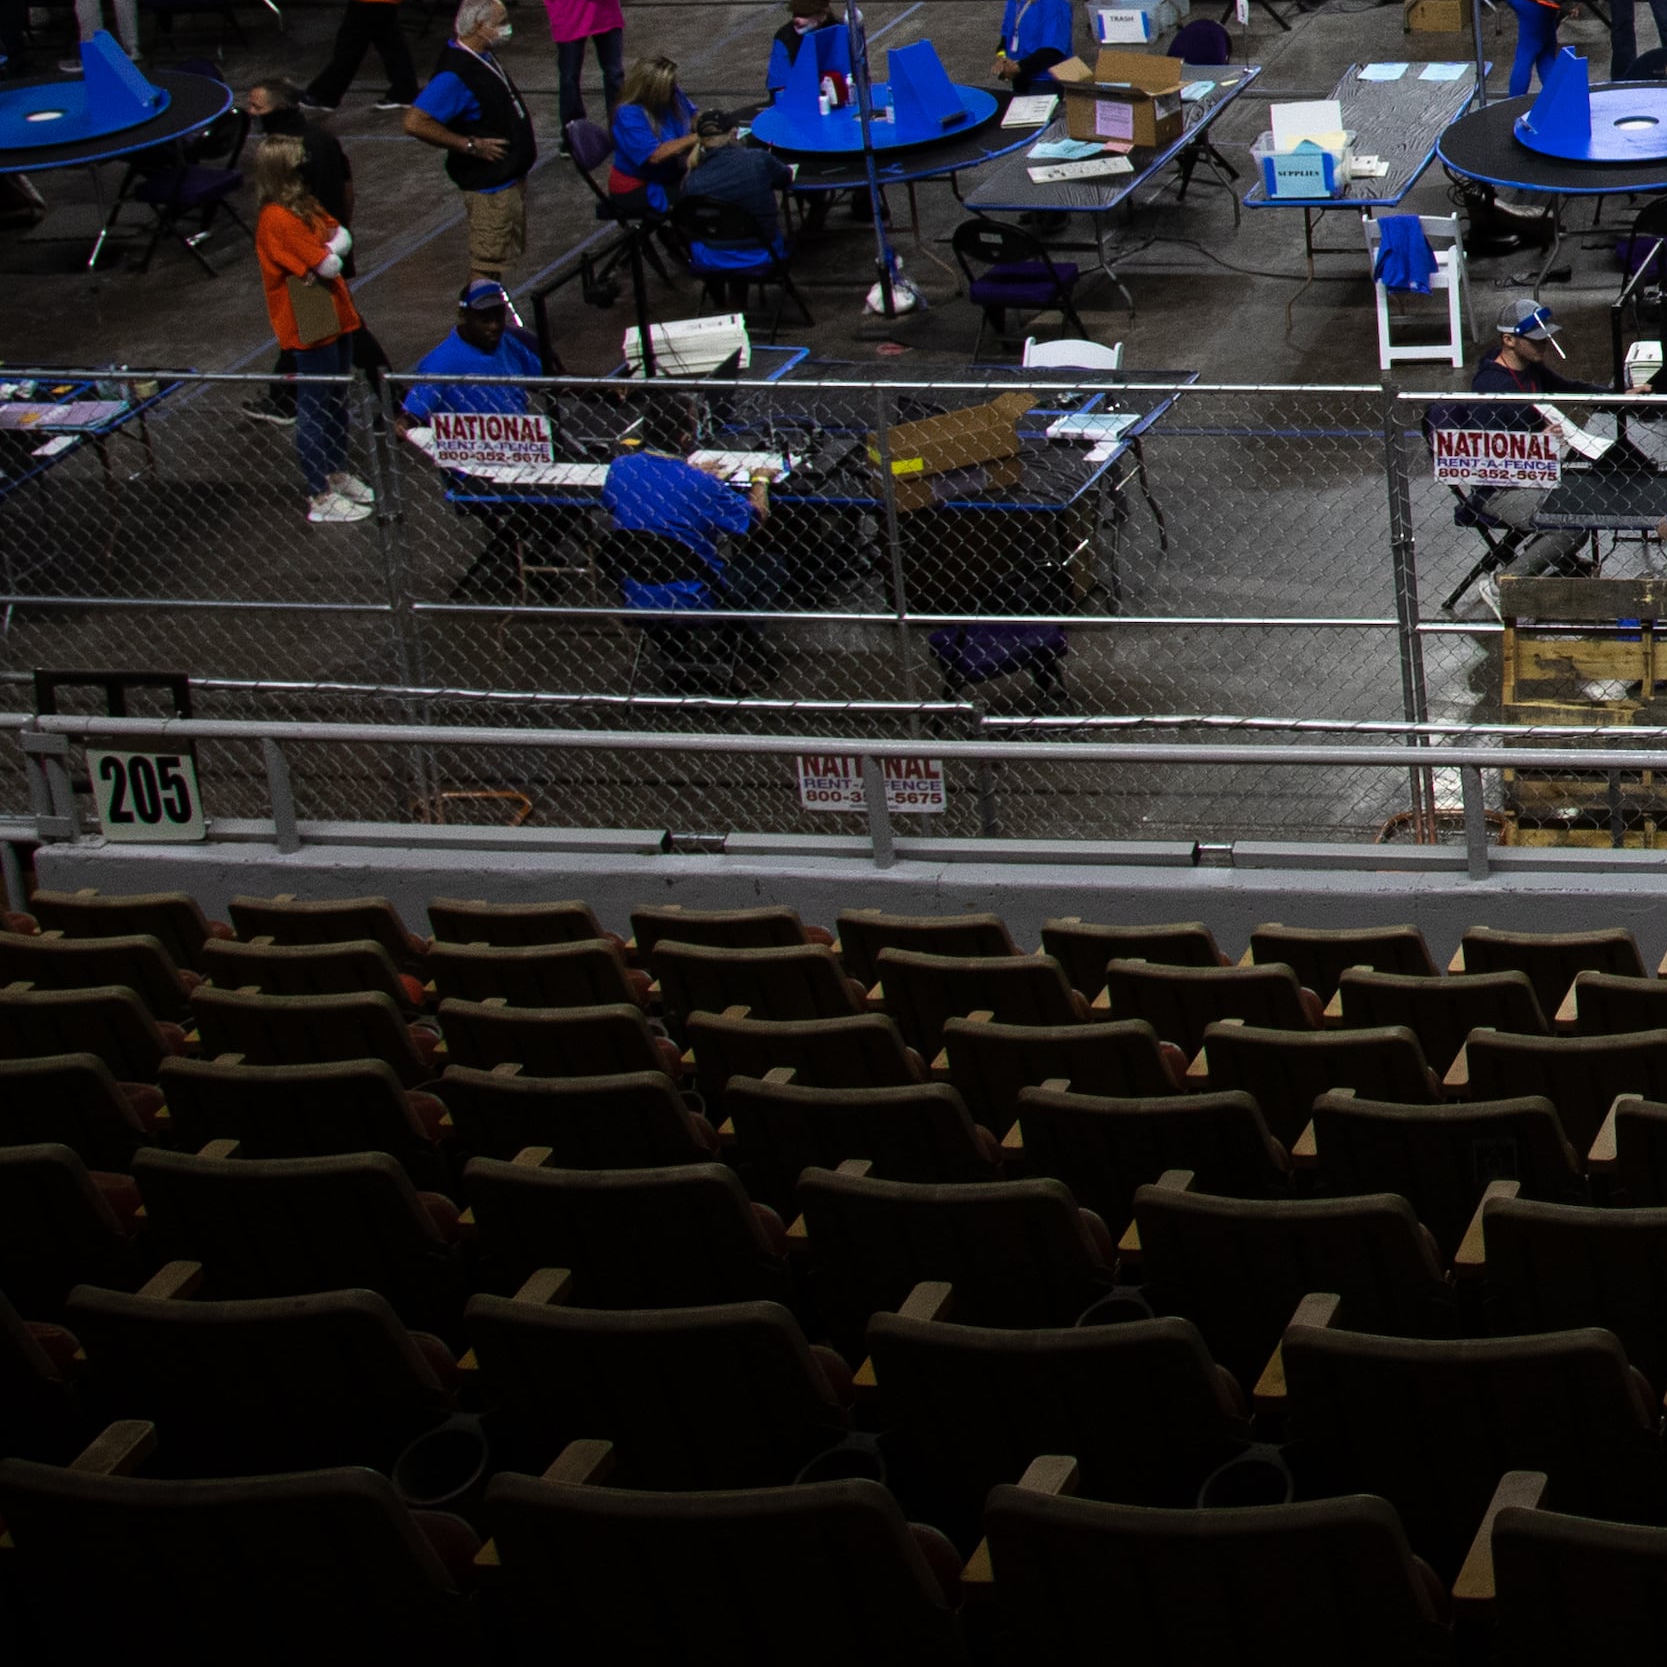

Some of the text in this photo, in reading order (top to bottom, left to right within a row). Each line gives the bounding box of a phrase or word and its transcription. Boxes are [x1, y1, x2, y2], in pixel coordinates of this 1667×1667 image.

[435, 415, 550, 443] NATIONAL
[436, 441, 550, 453] RENT-A-FENCE
[1437, 432, 1558, 461] NATIONAL
[1437, 458, 1557, 471] RENT-A-FENCE
[1438, 468, 1557, 481] 800-352-5675
[802, 754, 941, 780] NATINAL
[100, 756, 192, 825] 205
[806, 791, 943, 804] 800-3-5675
